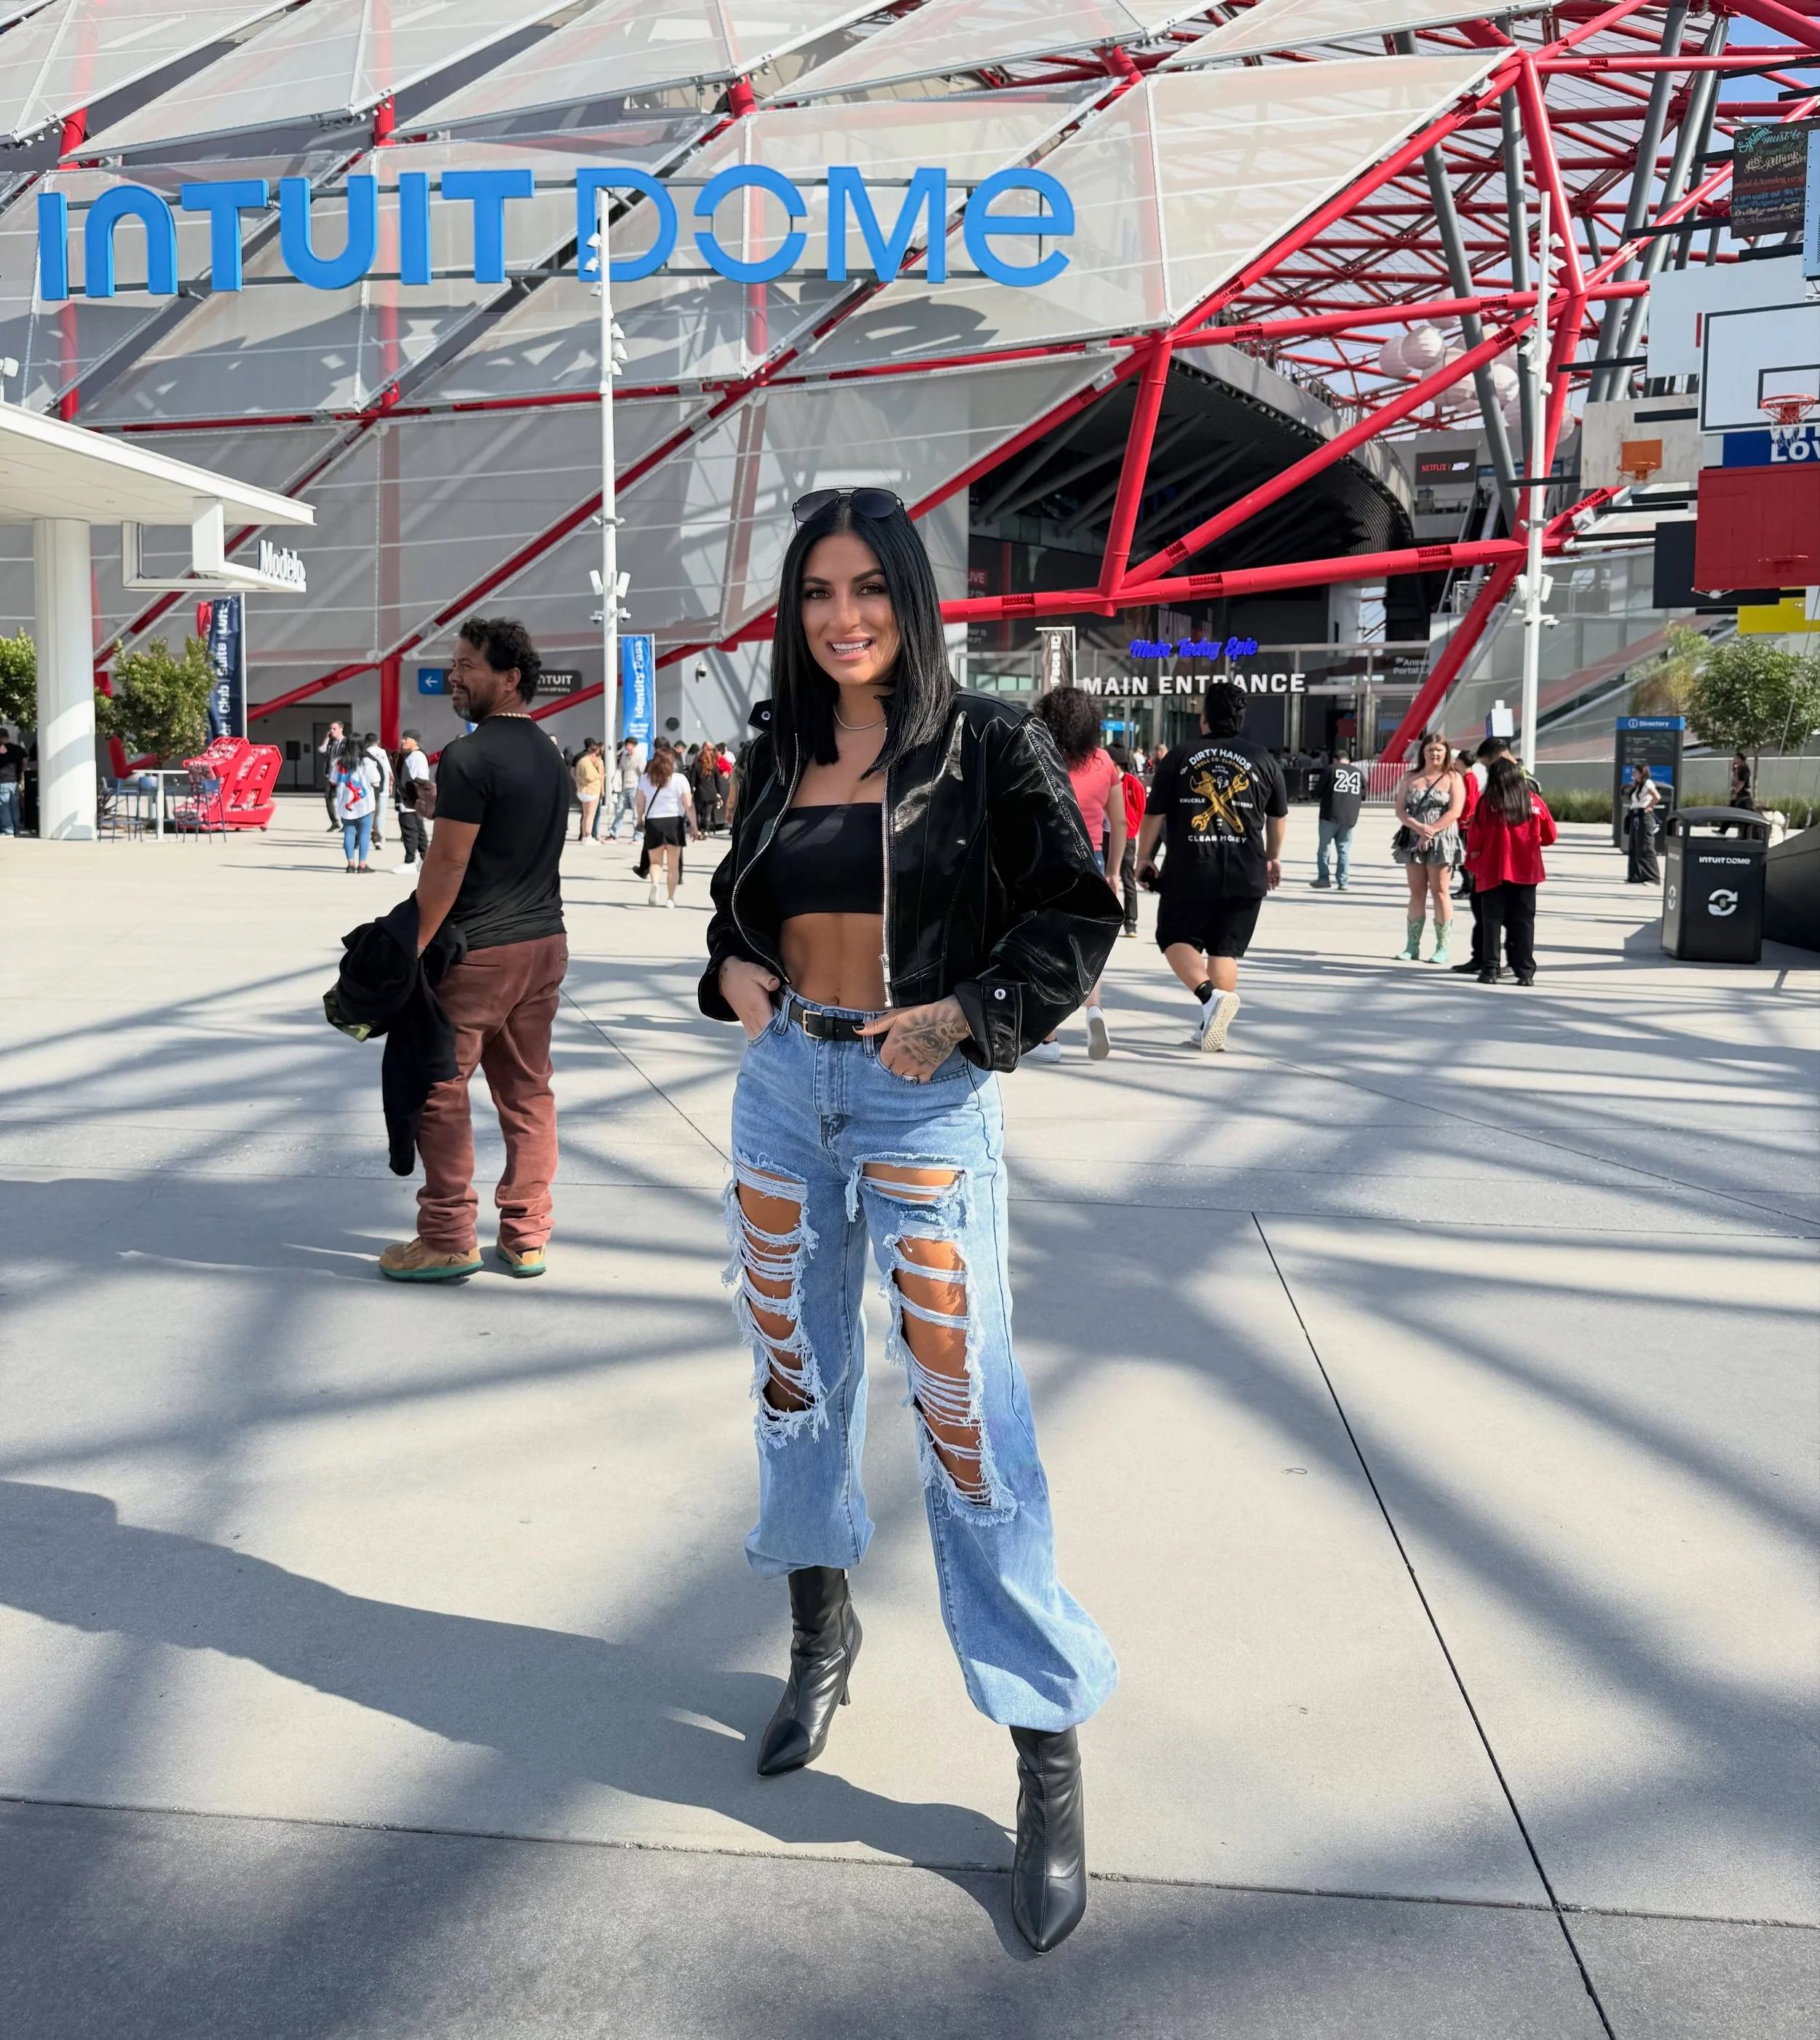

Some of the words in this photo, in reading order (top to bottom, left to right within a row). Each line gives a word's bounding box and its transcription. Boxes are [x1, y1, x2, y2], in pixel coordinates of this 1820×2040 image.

[1421, 463, 1447, 472] NETFLIX
[258, 539, 306, 581] Modelo
[216, 642, 228, 676] Suite
[1129, 639, 1173, 658] Make
[1176, 637, 1222, 661] Today
[1224, 636, 1259, 661] Epic
[538, 674, 573, 685] nTUIT
[1393, 667, 1419, 675] Portal
[634, 672, 646, 719] Identity
[1082, 676, 1148, 695] MAIN
[218, 685, 231, 714] Club
[1639, 720, 1670, 728] Directory
[1189, 748, 1218, 766] DIRTY
[1219, 748, 1252, 770] HANDS
[1334, 769, 1361, 794] 24
[1187, 834, 1218, 842] CLEAN
